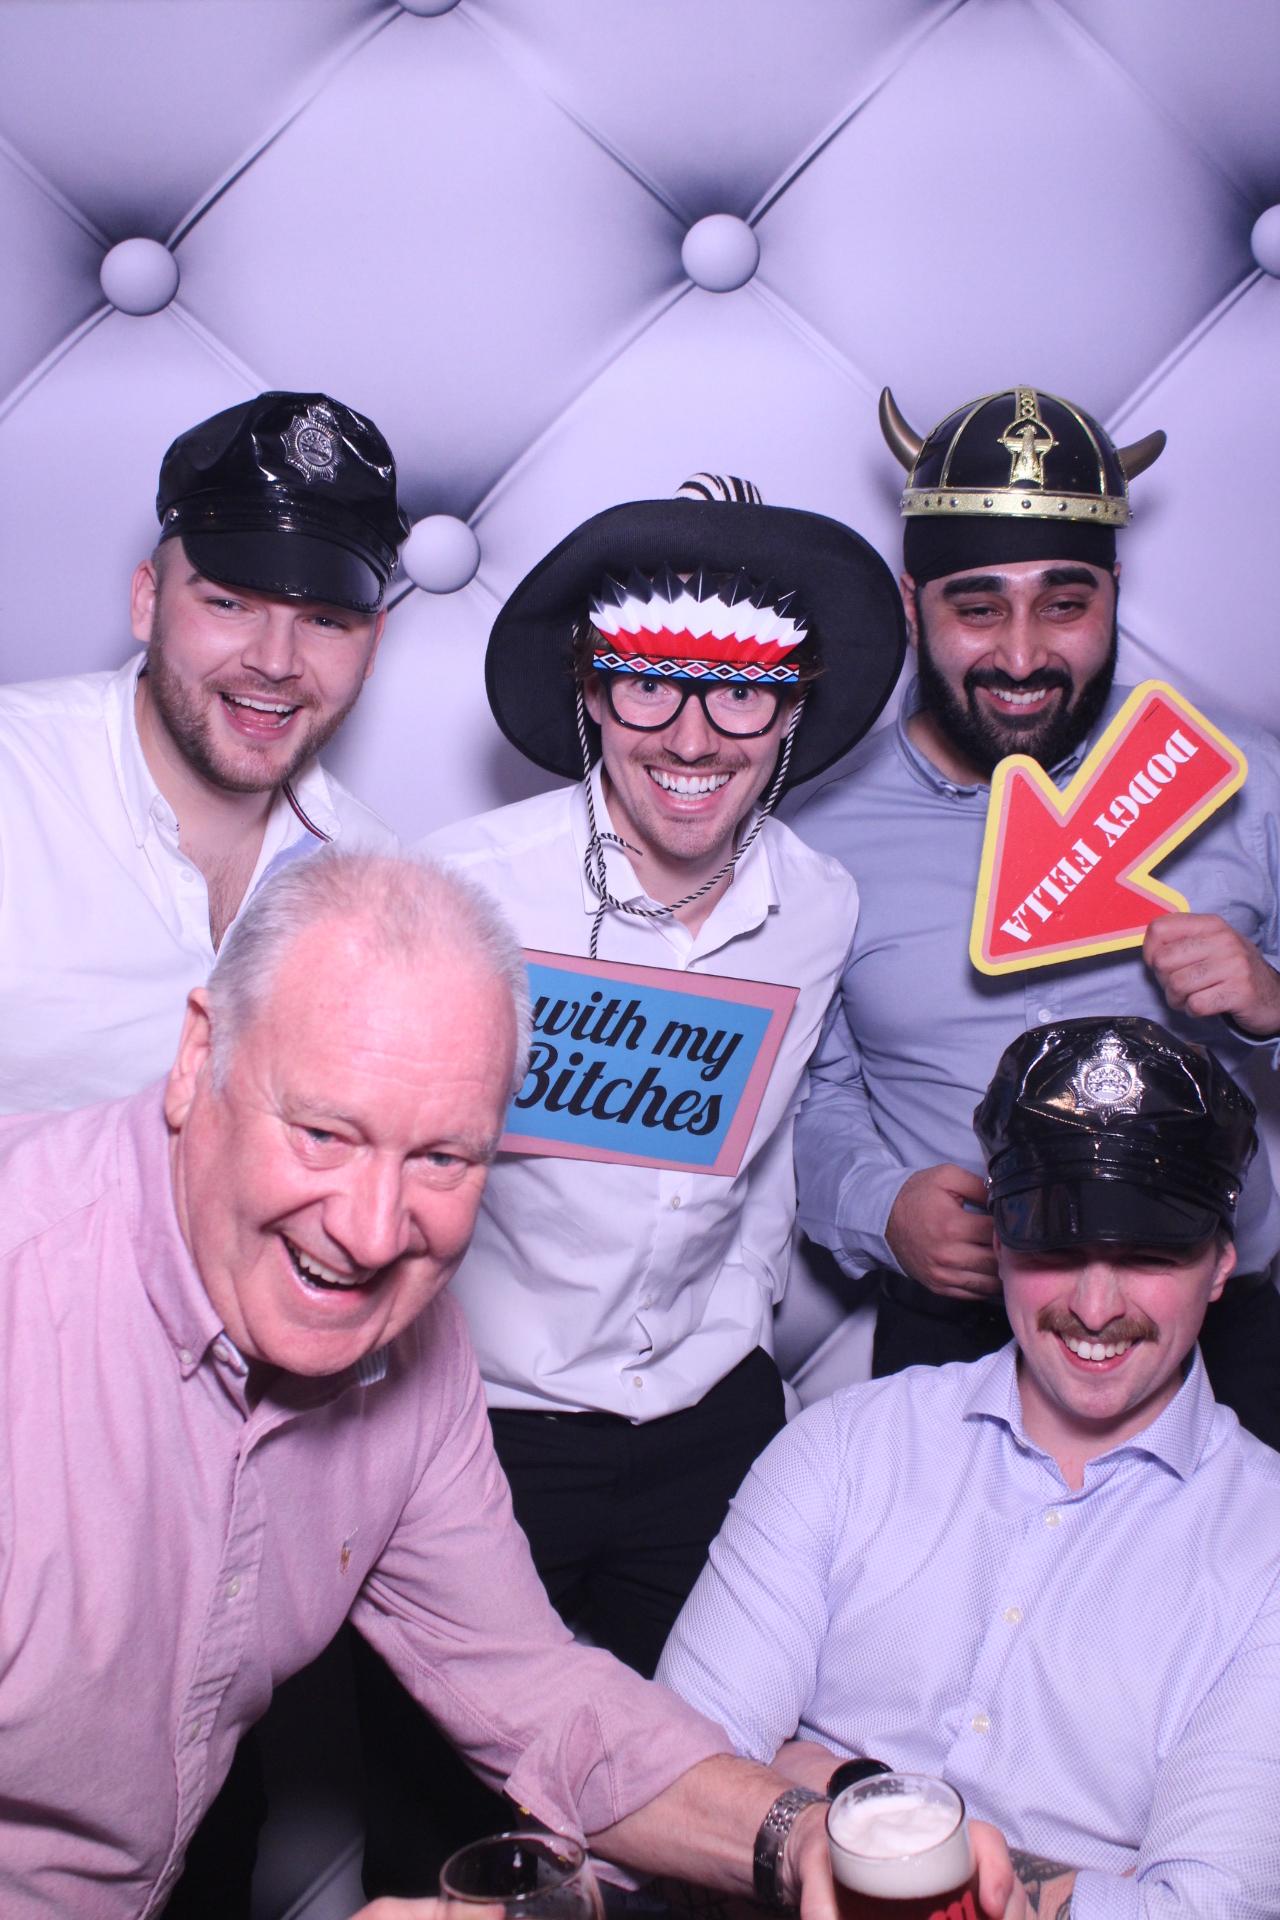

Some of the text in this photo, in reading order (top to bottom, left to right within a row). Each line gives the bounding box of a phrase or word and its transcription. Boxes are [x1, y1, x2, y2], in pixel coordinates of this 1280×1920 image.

[1000, 729, 1199, 943] DODGY FELLA
[530, 991, 744, 1082] with my
[514, 1041, 723, 1136] Bitches
